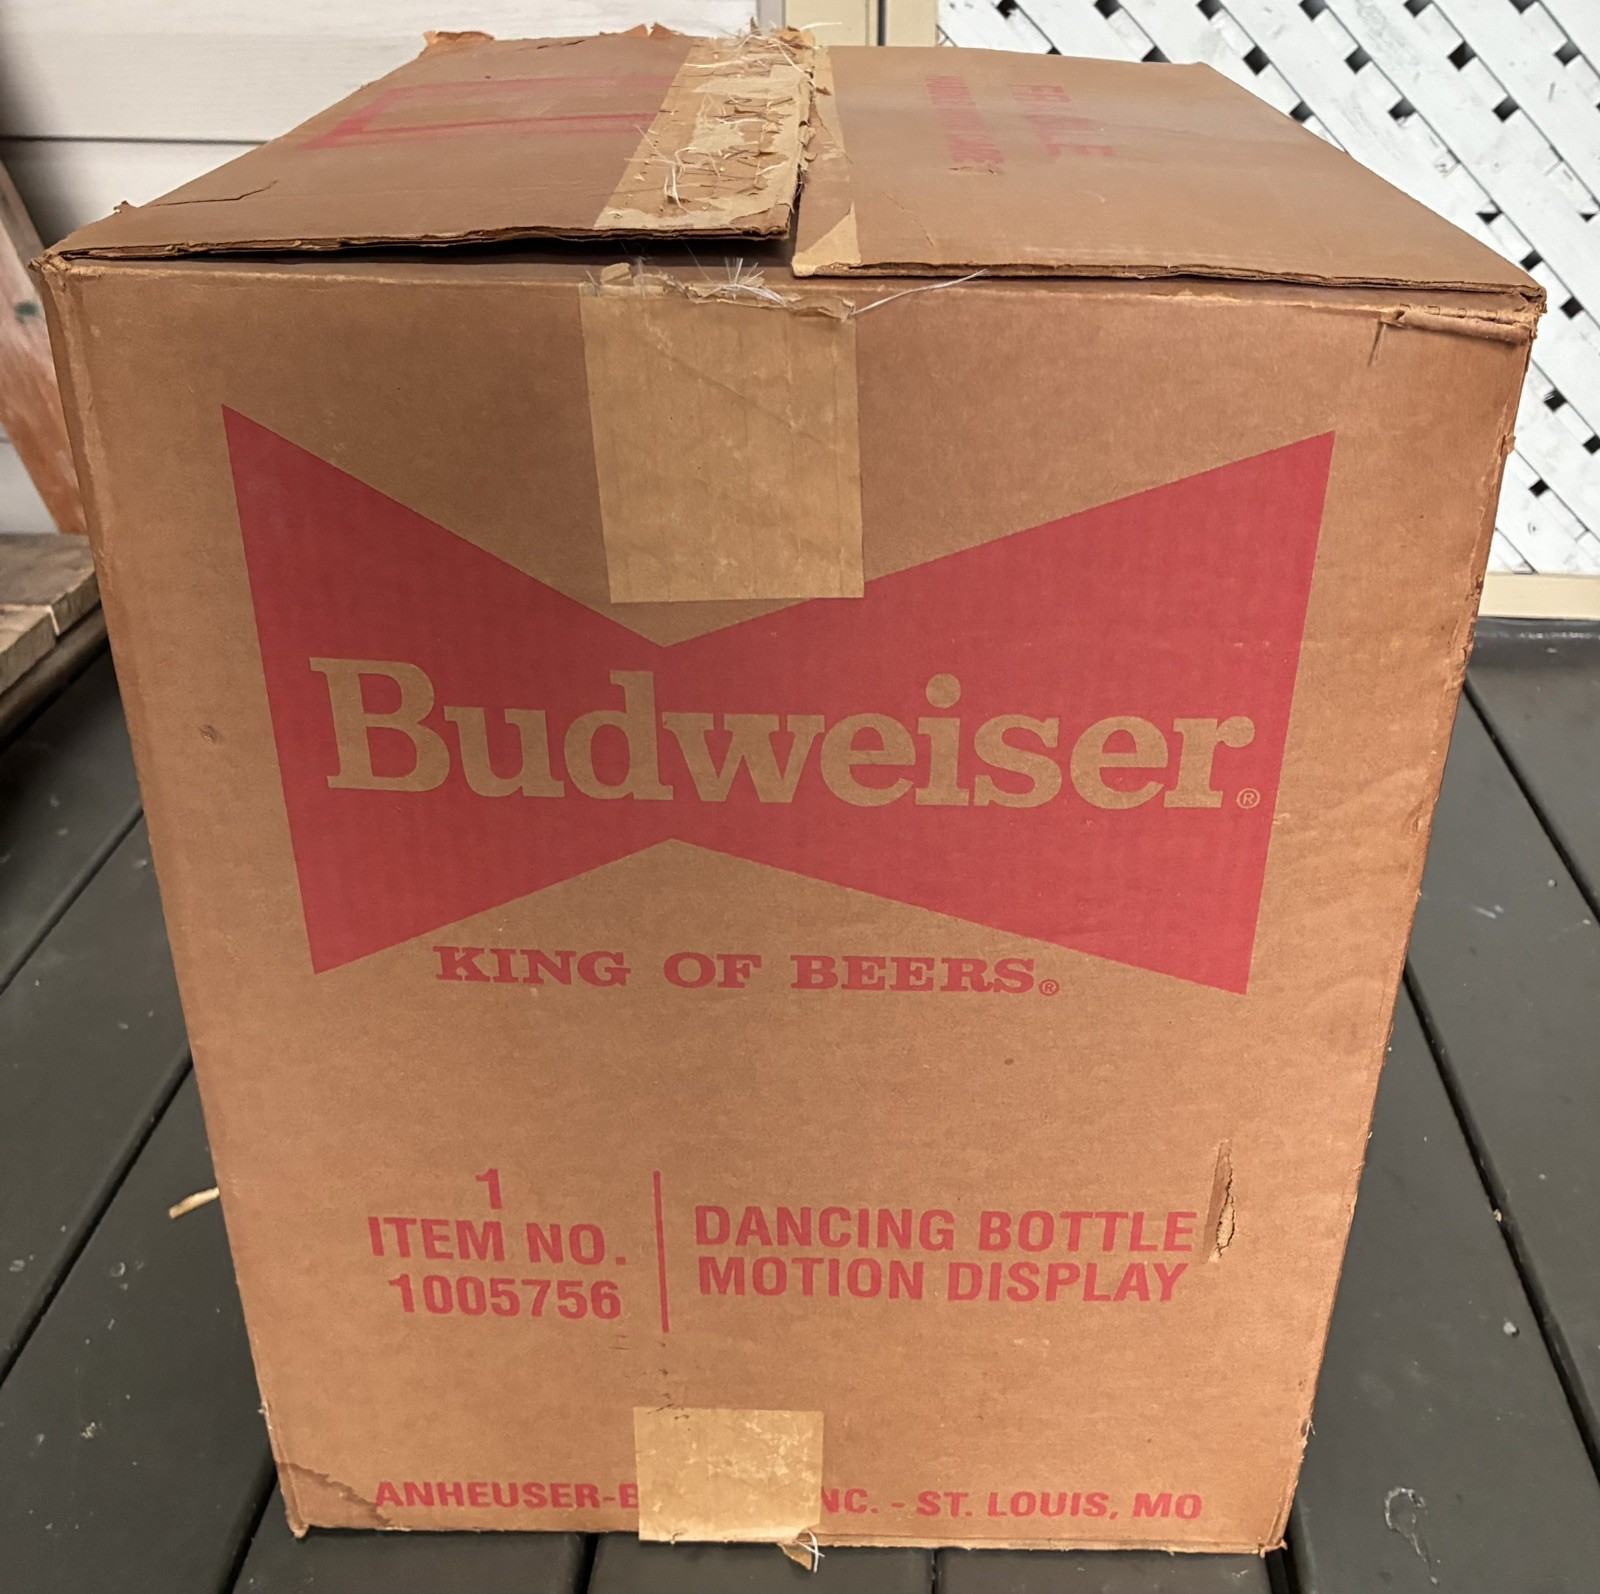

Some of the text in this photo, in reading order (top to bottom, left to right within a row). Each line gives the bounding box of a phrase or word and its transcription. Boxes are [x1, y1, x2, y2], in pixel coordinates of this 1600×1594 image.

[433, 946, 630, 987] KING
[664, 952, 761, 989] OF
[476, 1169, 503, 1210] 1
[368, 1216, 626, 1267] ITEM NO.
[695, 1206, 1197, 1253] DANCING BOTTLE
[390, 1273, 621, 1320] 1005756
[699, 1256, 1190, 1303] MOTION DISPLAY
[375, 1481, 639, 1509] ANHEUSER-B
[821, 1487, 878, 1514] NC.
[916, 1490, 973, 1517] ST.
[987, 1491, 1118, 1520] LOUIS,
[1132, 1493, 1203, 1520] MO
